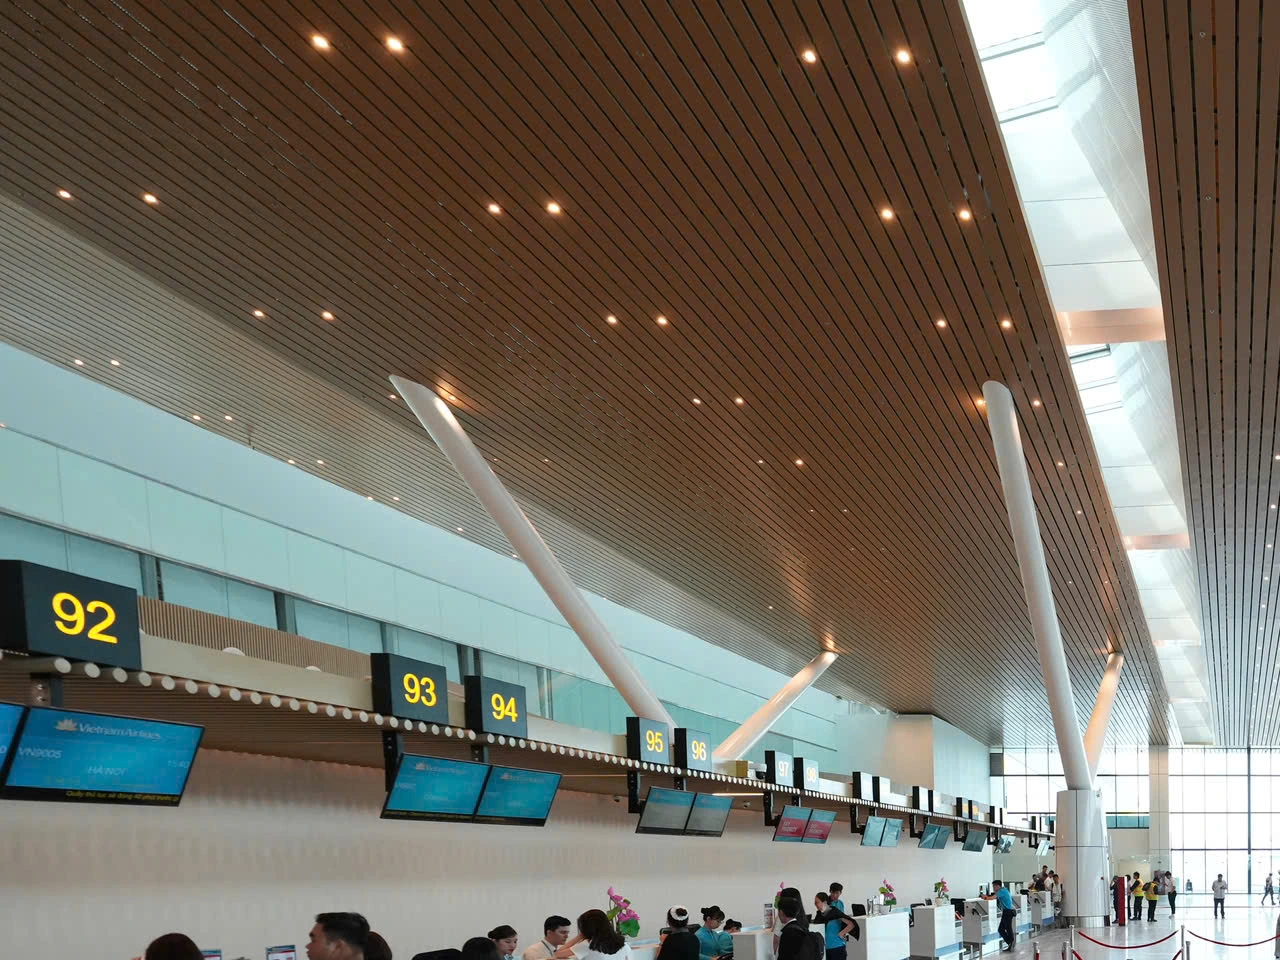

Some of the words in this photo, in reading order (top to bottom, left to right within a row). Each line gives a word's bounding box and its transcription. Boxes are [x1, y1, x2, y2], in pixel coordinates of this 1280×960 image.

[52, 591, 119, 644] 92
[403, 673, 437, 707] 93
[491, 693, 519, 723] 94
[646, 730, 664, 753] 95
[691, 740, 707, 761] 96
[777, 761, 790, 777] 97
